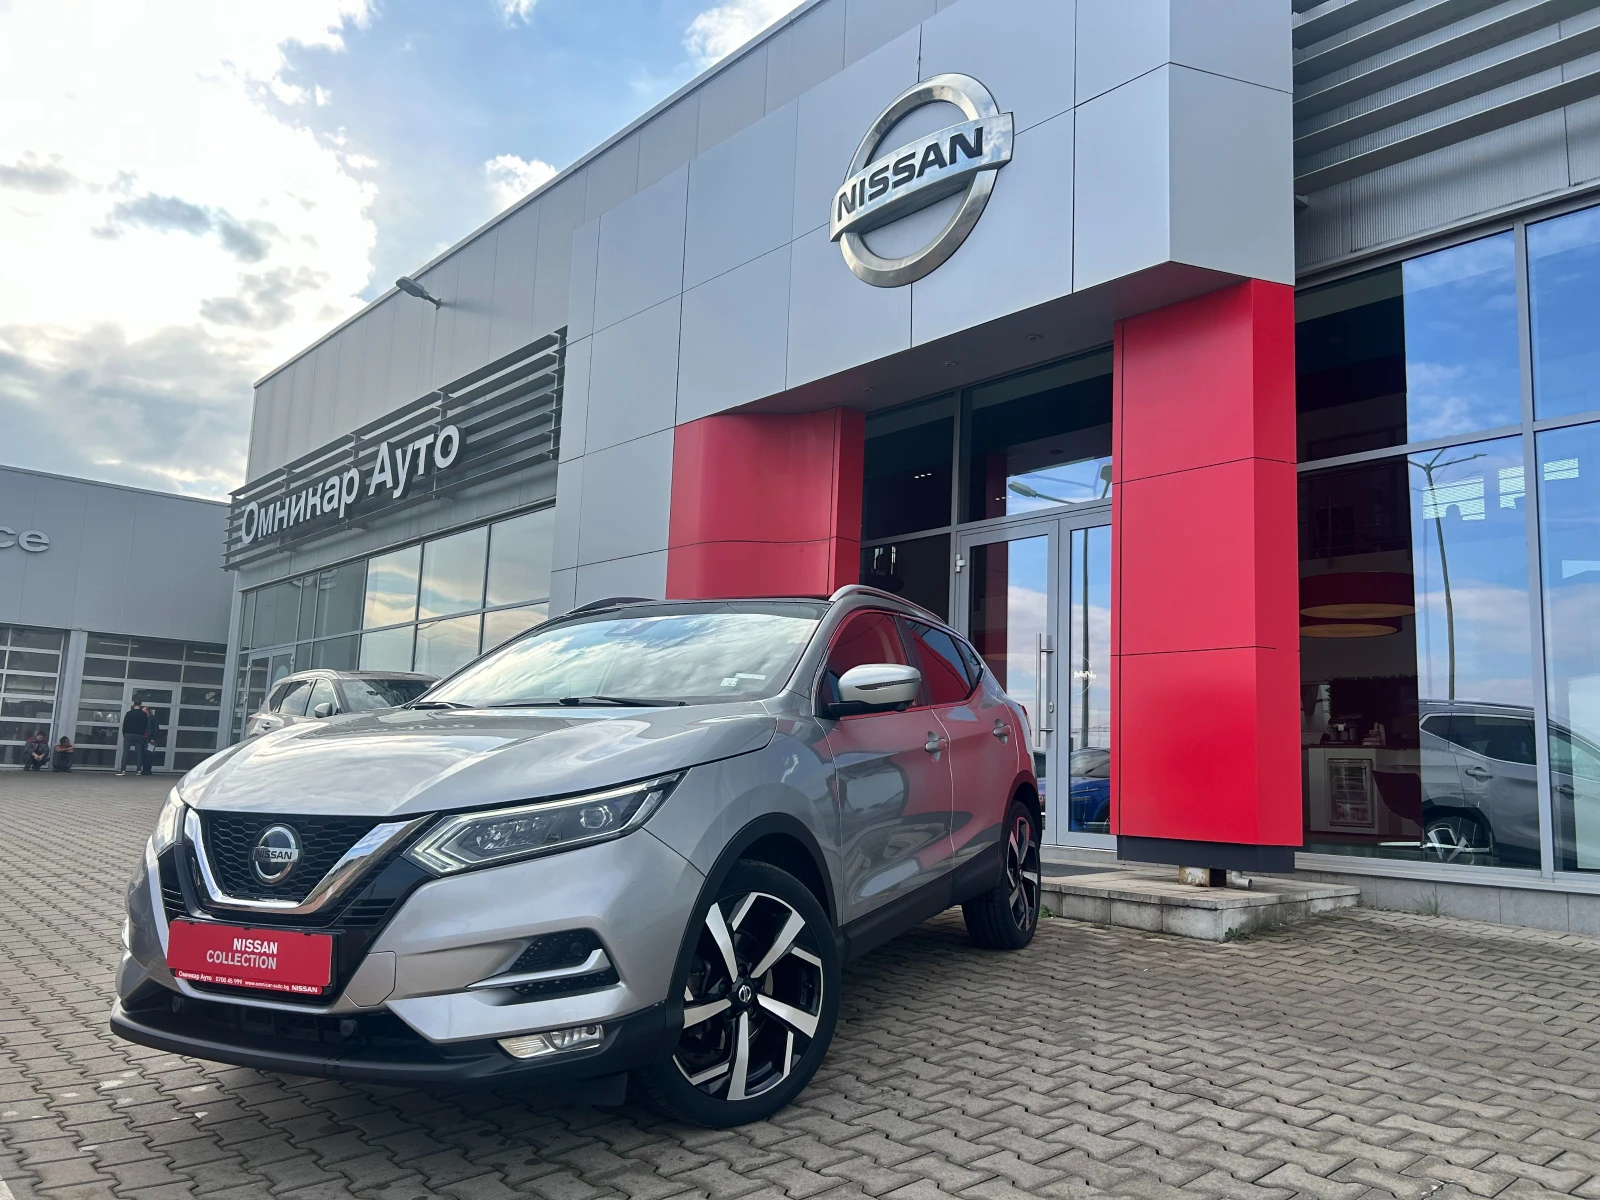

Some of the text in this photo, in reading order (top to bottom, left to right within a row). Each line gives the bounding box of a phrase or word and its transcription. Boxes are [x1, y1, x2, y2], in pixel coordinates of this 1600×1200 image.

[837, 126, 984, 223] NISSAN
[241, 424, 461, 544] Омникар Ауто
[254, 850, 293, 860] NISSAN
[233, 938, 278, 955] NISSAN
[206, 950, 277, 970] COLLECTION
[291, 984, 318, 993] NISSAN
